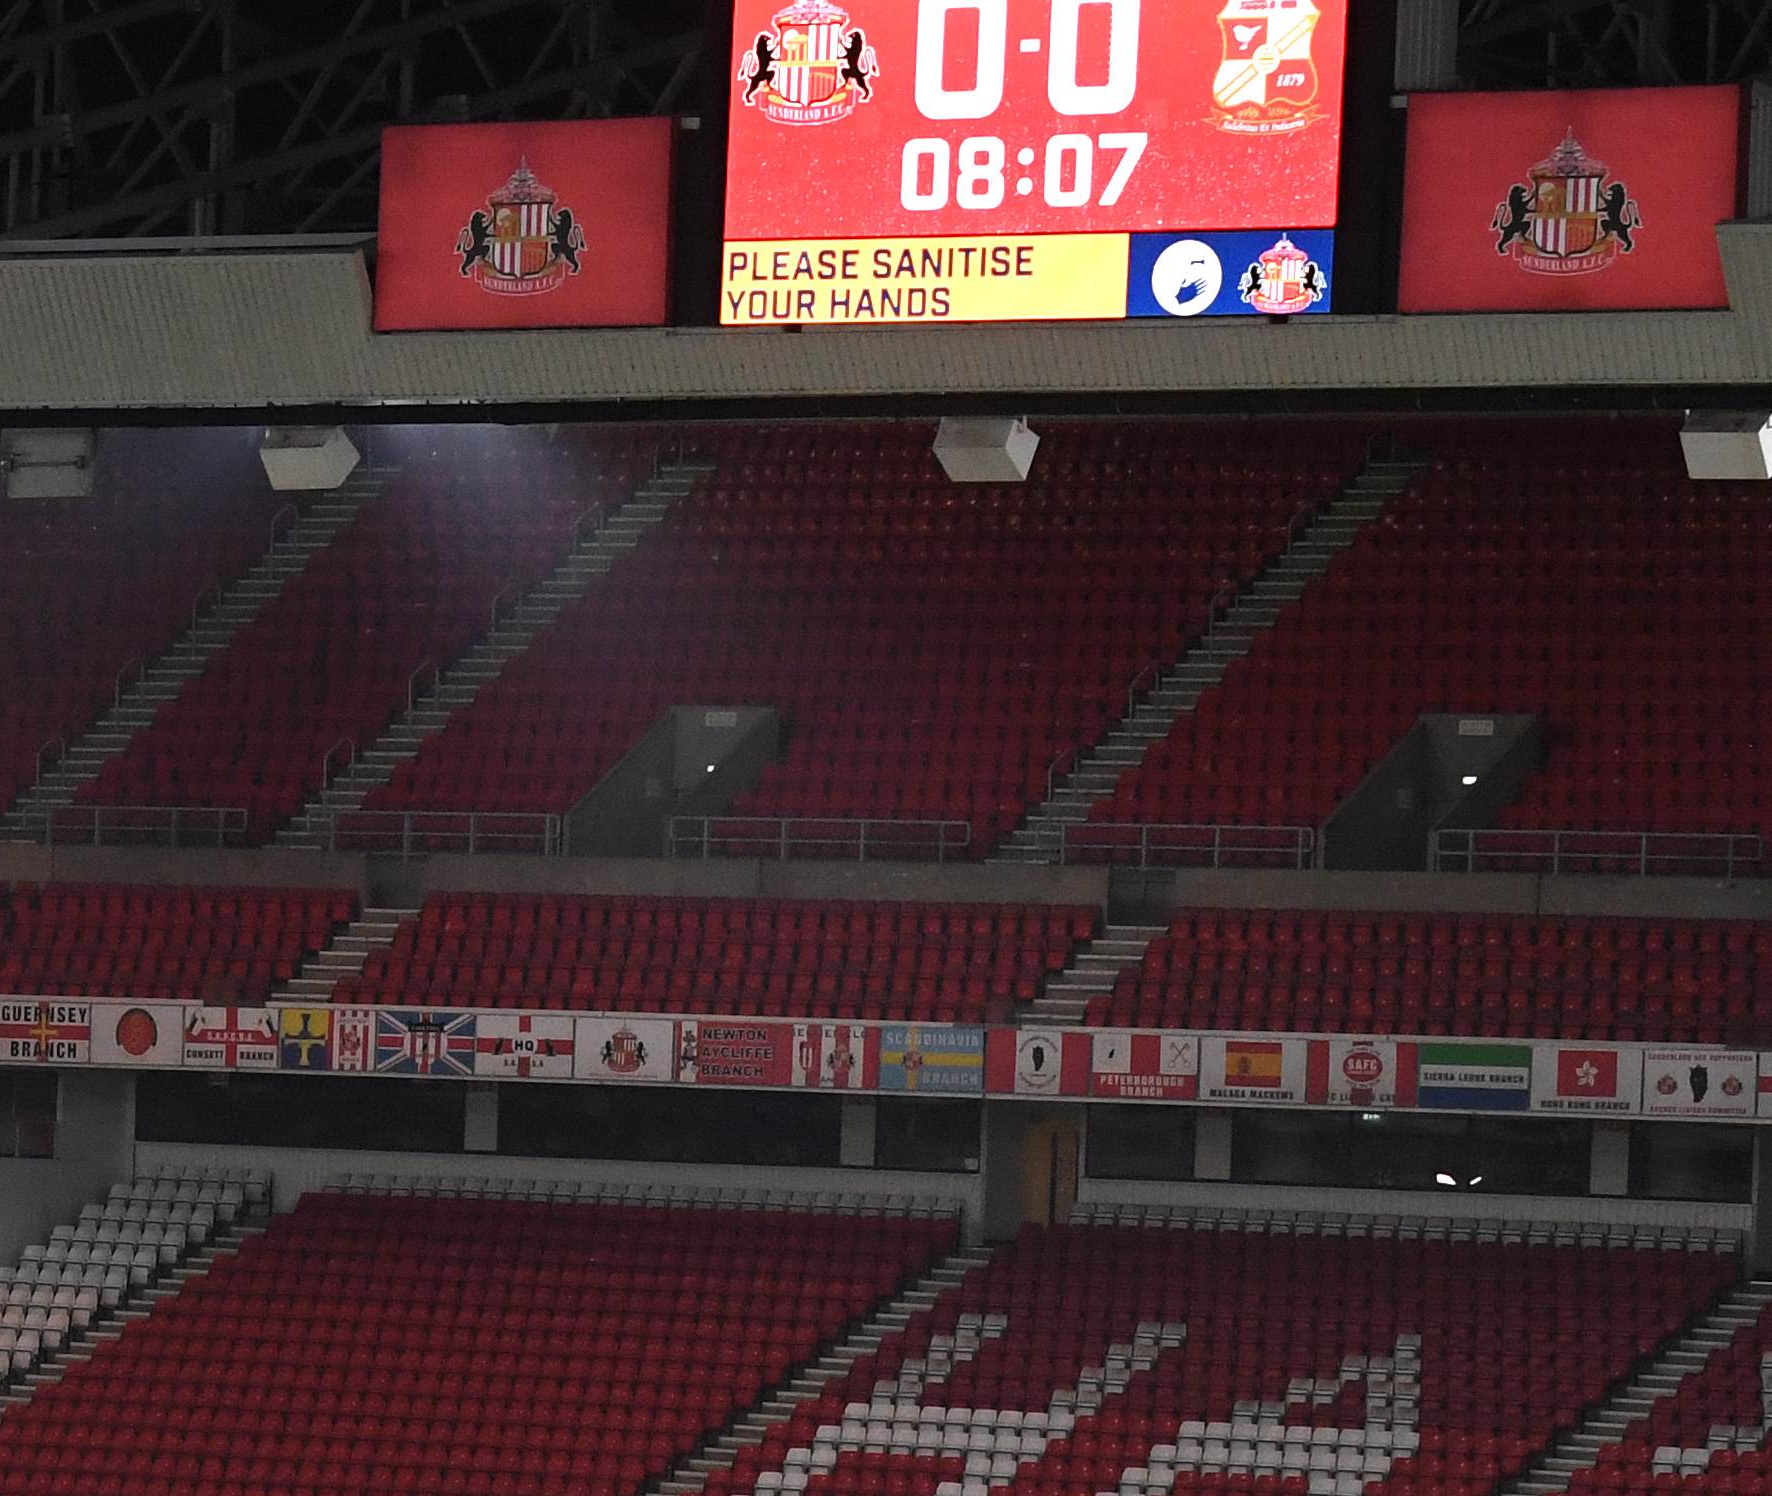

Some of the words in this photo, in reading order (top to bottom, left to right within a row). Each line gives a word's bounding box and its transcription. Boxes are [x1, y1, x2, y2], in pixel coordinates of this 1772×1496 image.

[915, 0, 1140, 120] 0-0
[1276, 73, 1305, 87] 1879
[767, 104, 821, 120] SUNDERLAND
[900, 132, 1148, 211] 08:07
[729, 250, 860, 281] PLEASE
[873, 246, 1034, 279] SANITISE
[1521, 254, 1579, 271] SUNDERLAND
[727, 289, 818, 320] YOUR
[830, 287, 952, 318] HANDS
[1, 1005, 88, 1023] GUERNSEY
[702, 1029, 767, 1041] NEWTON
[885, 1031, 980, 1048] SCANDINAVIA
[10, 1041, 77, 1058] BRANCH
[515, 1040, 534, 1051] HQ
[186, 1048, 224, 1060] CONSETT
[239, 1050, 275, 1061] BRANCH
[701, 1047, 773, 1059] AYCLIFFE
[1346, 1058, 1378, 1070] SAFC
[701, 1066, 764, 1077] BRANCH
[1423, 1071, 1456, 1081] SIERRA
[1459, 1073, 1486, 1082] LEONE
[1489, 1074, 1525, 1083] BRANCH
[922, 1072, 979, 1086] BRANCH
[1099, 1075, 1185, 1087] PETERBOROUGH
[1120, 1086, 1164, 1097] BRANCH
[1209, 1088, 1246, 1098] MALAGA
[1250, 1089, 1295, 1100] MACKEMS
[1540, 1099, 1565, 1108] HONG
[1567, 1100, 1592, 1109] KONG
[1594, 1101, 1631, 1110] BRANCH
